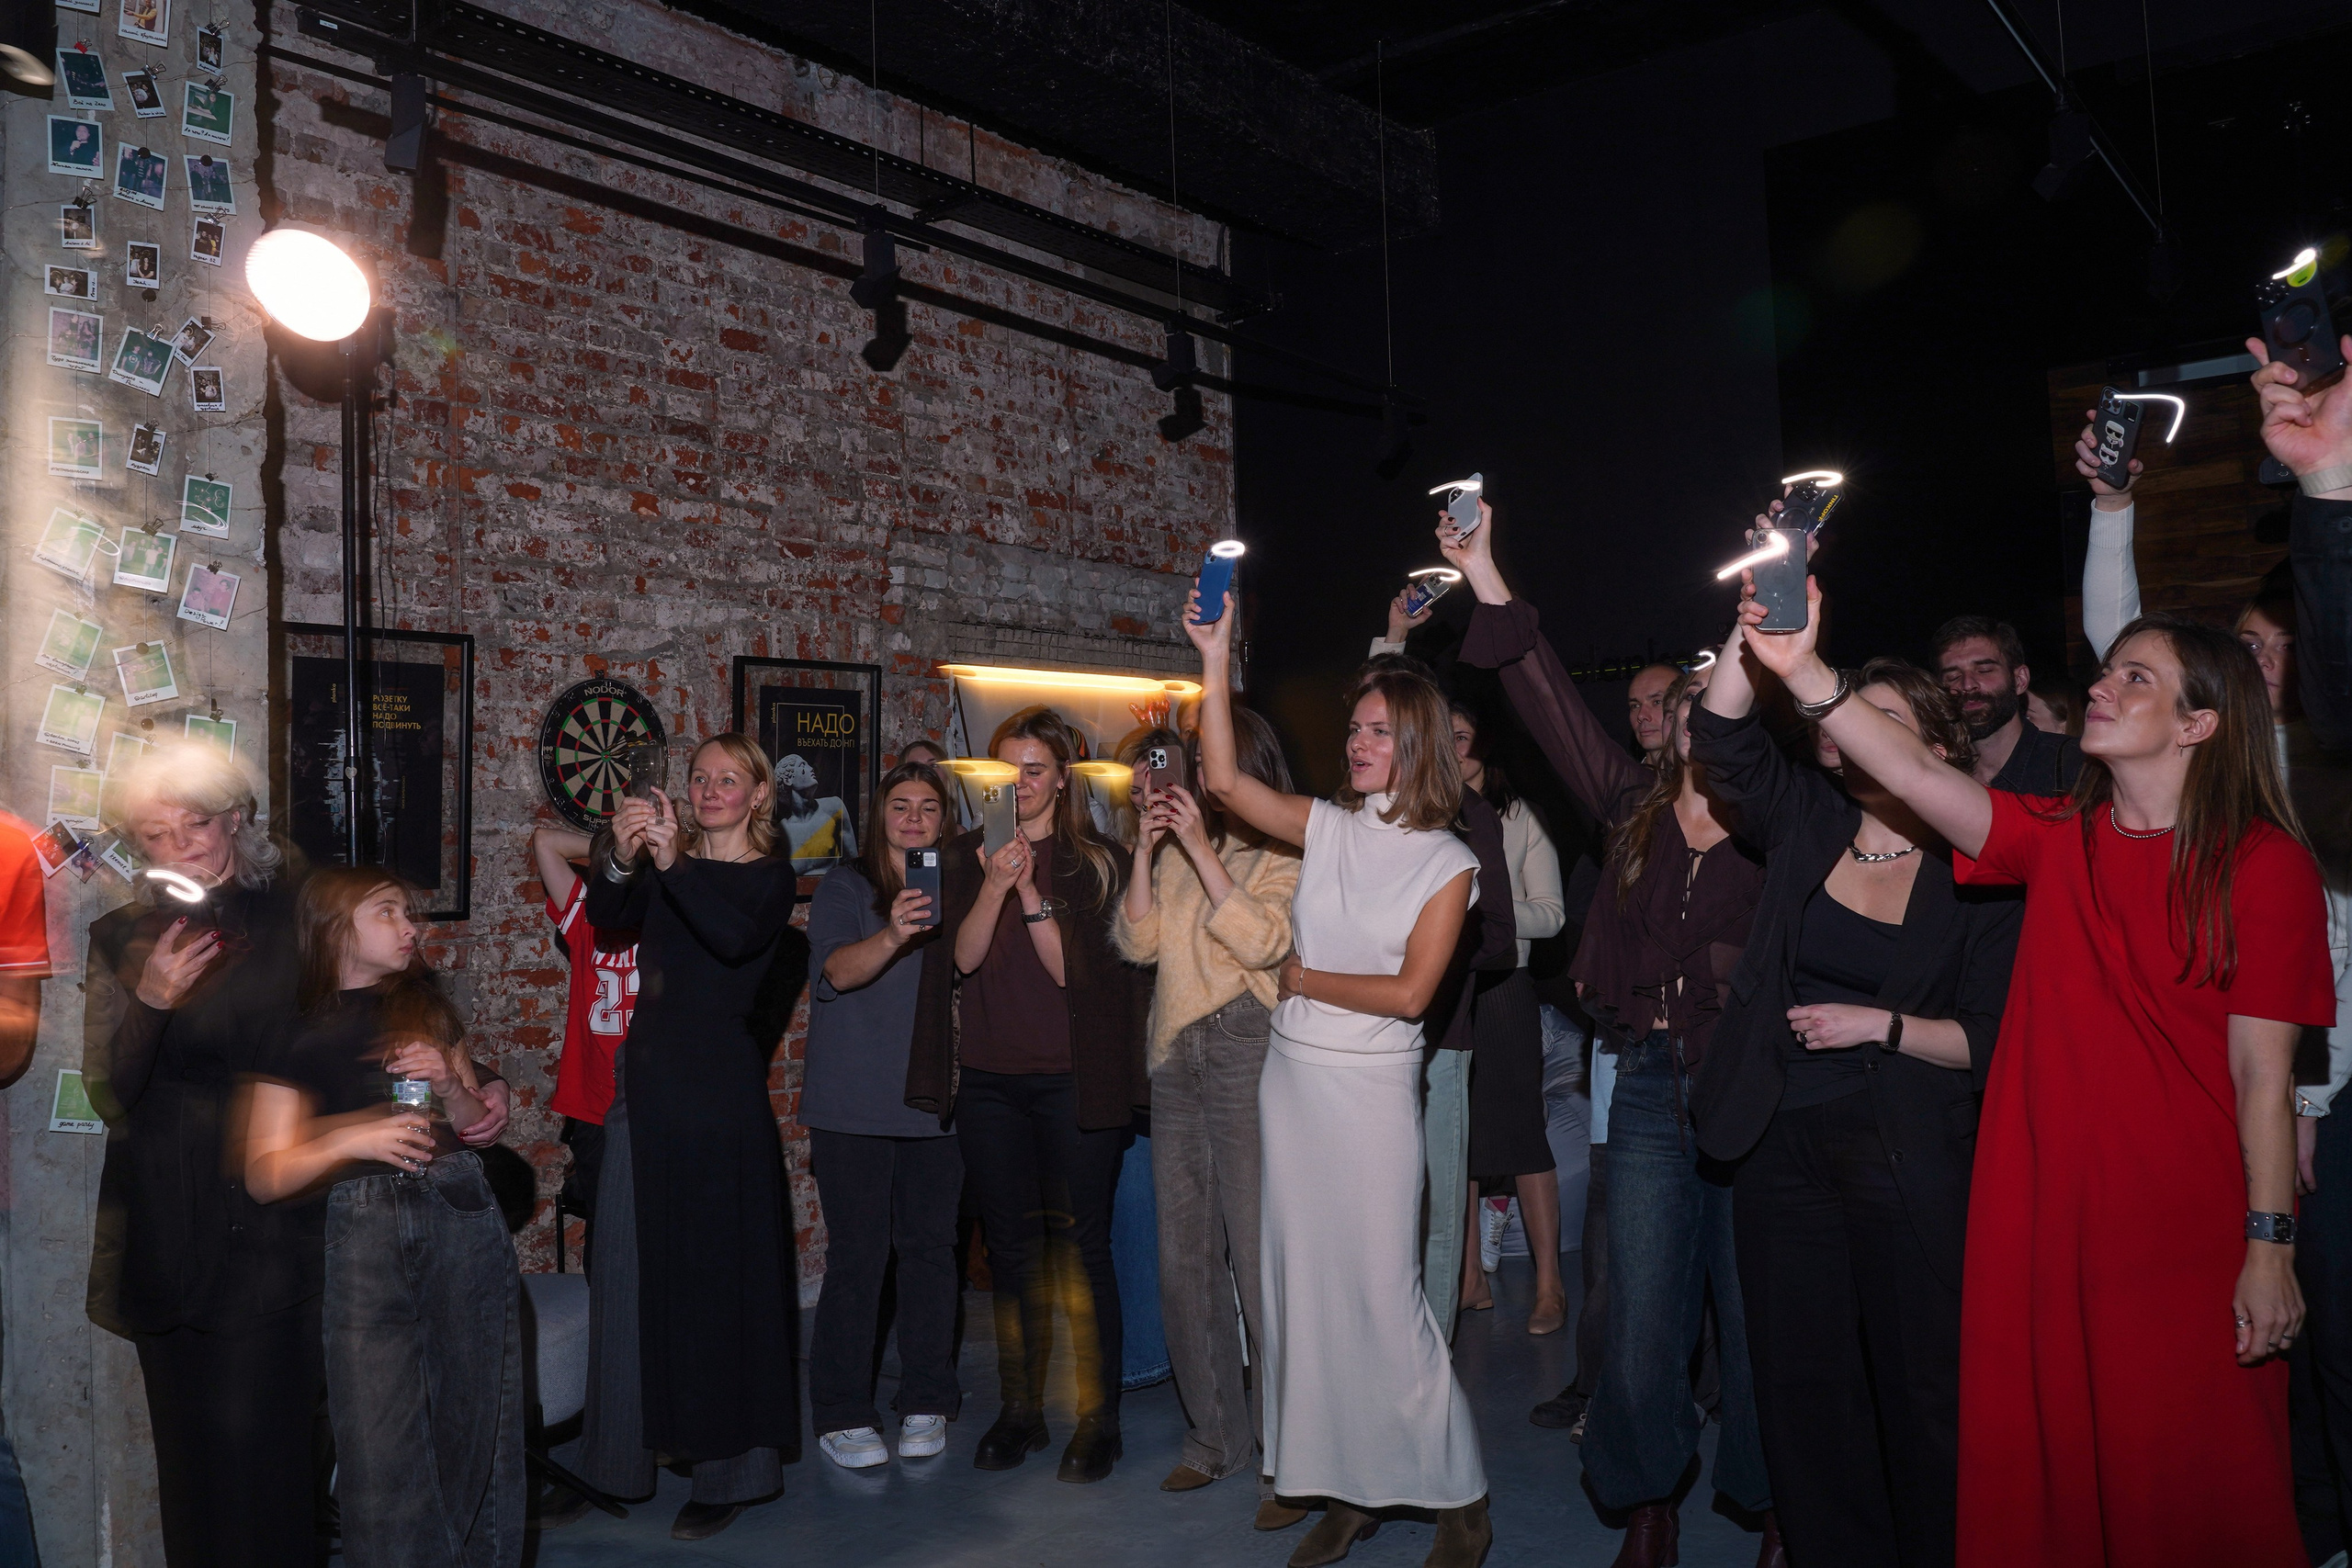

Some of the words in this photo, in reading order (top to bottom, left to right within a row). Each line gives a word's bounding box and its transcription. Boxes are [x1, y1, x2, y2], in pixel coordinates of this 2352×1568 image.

[583, 685, 626, 697] NODOR
[372, 694, 408, 704] РОЗЕТКУ
[372, 702, 411, 712] ВСЁ-ТАКИ
[372, 712, 397, 721] НАДО
[372, 720, 422, 730] ПОДВИНУТЬ
[797, 711, 855, 738] НАДО
[797, 737, 829, 748] ВЪЕХАТЬ
[829, 738, 842, 749] ДО
[76, 1122, 95, 1131] party
